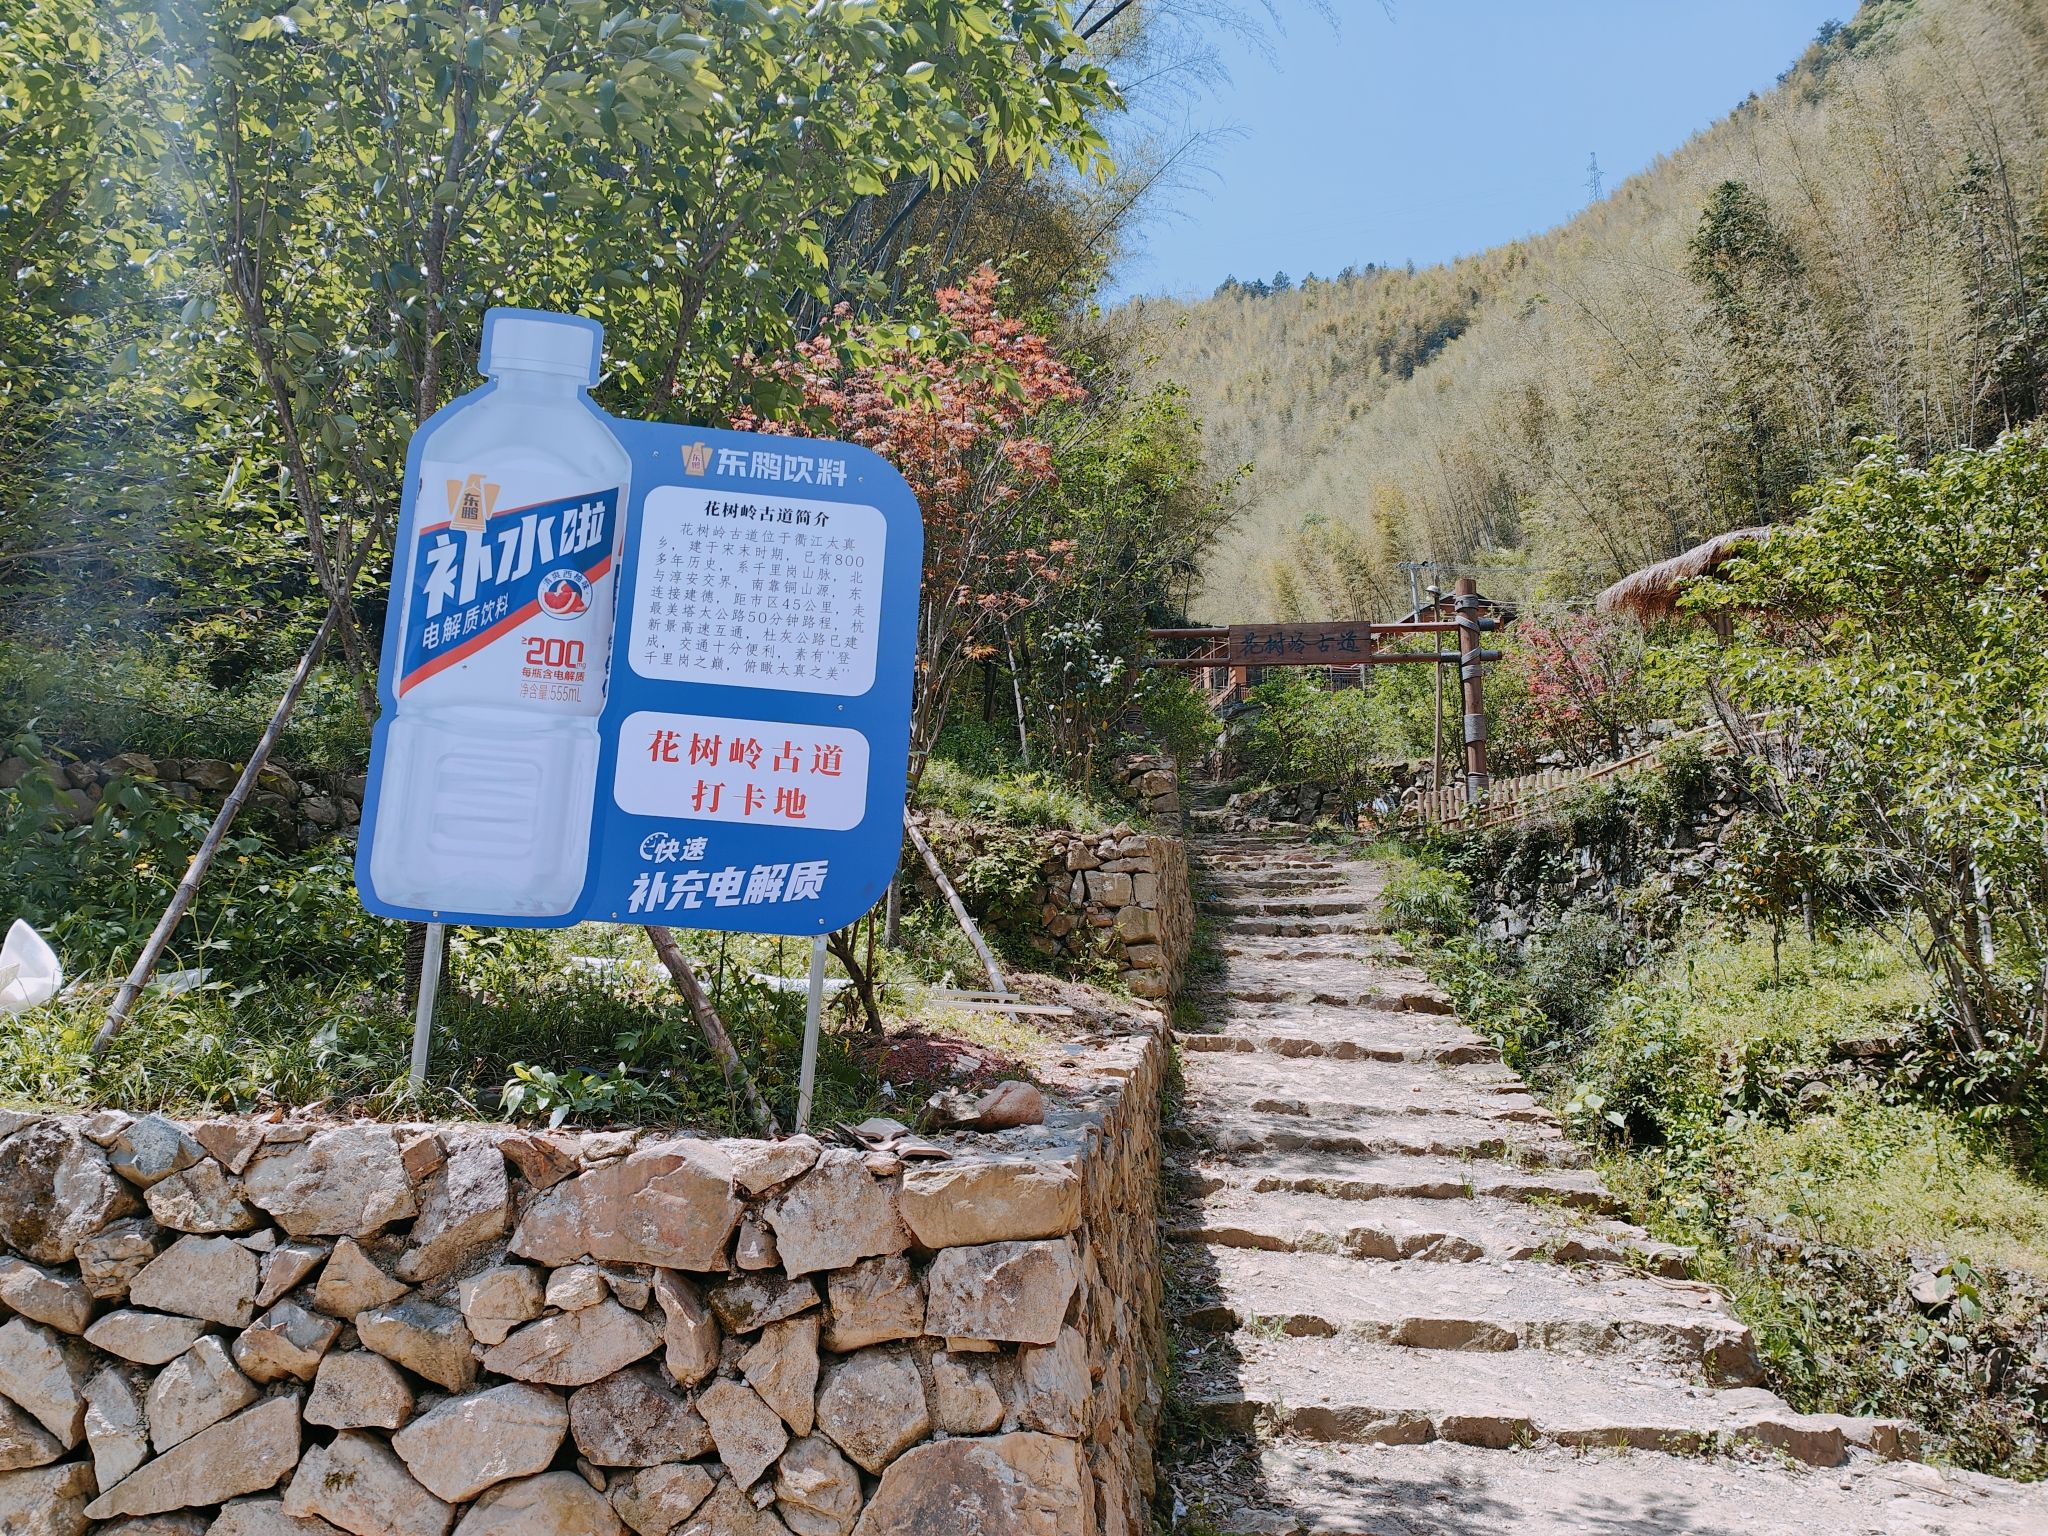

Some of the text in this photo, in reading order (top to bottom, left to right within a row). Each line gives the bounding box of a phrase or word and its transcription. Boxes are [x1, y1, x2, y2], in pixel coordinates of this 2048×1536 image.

[717, 448, 847, 487] 东鹏饮料
[460, 493, 481, 520] 东鹏
[704, 500, 830, 527] 花树岭古道简介
[680, 523, 856, 552] 花树岭古道位于衢江太真
[423, 501, 605, 619] 补水啦
[422, 593, 509, 649] 电解质饮料
[522, 667, 585, 682] 每瓶含电解质
[648, 730, 844, 777] 花树岭古道
[691, 779, 807, 819] 打卡地
[654, 836, 709, 864] 快速
[628, 860, 829, 914] 补充电解质
